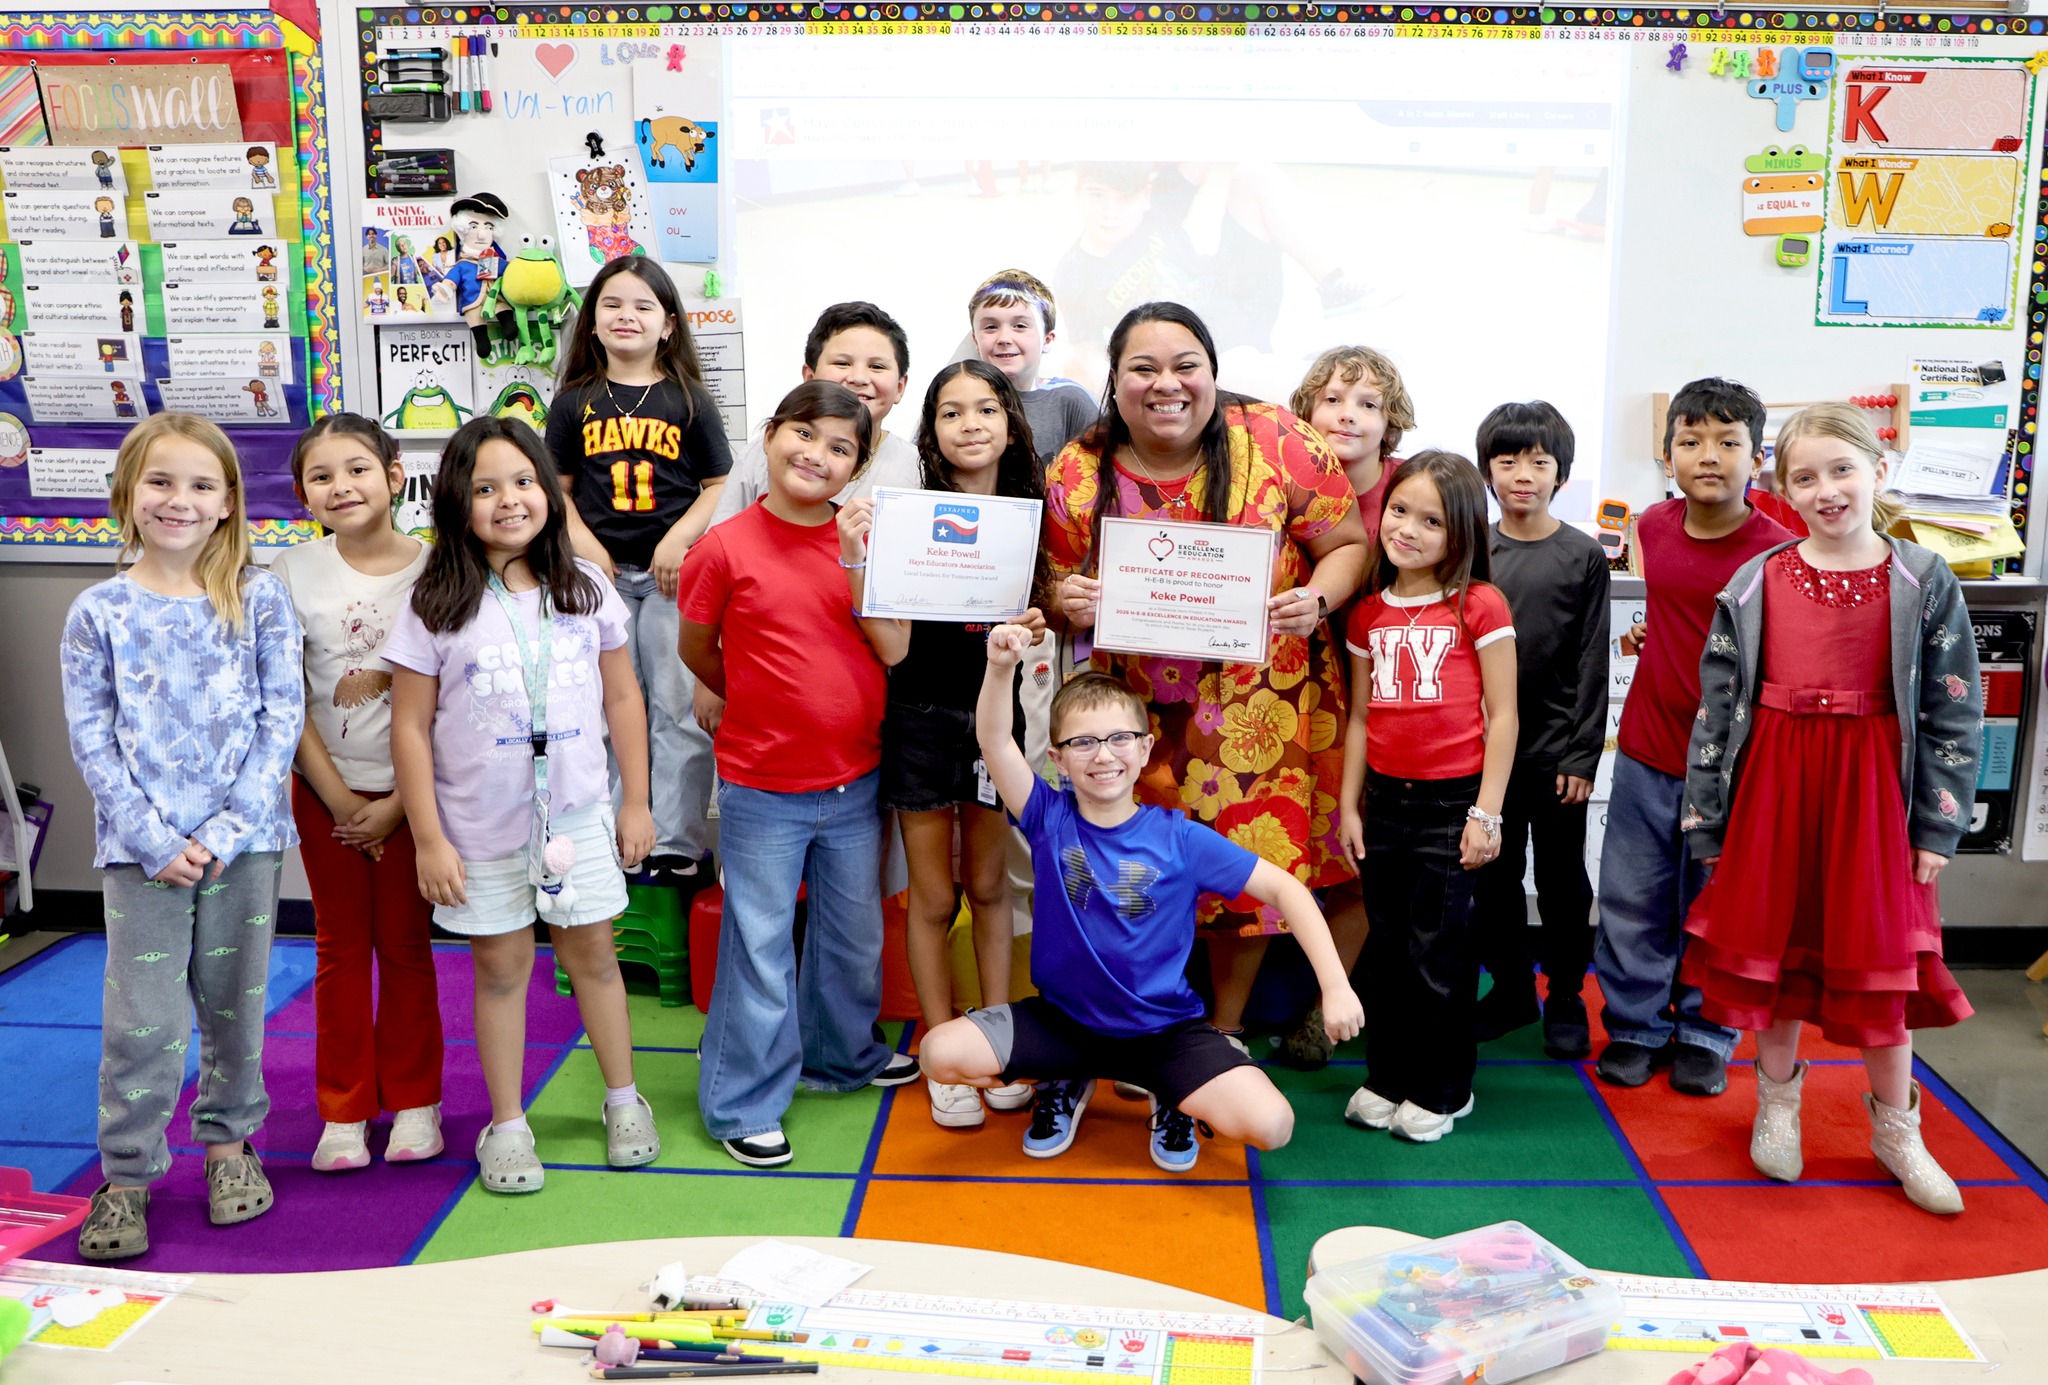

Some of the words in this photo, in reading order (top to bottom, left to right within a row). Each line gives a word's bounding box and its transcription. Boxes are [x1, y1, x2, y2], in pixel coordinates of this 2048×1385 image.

[377, 30, 382, 39] 0
[390, 30, 393, 38] 1
[403, 30, 408, 39] 2
[418, 29, 422, 38] 3
[430, 29, 436, 38] 4
[445, 29, 450, 38] 5
[486, 29, 491, 37] 8
[498, 29, 503, 37] 9
[509, 29, 518, 37] 10
[969, 27, 980, 35] 42
[985, 27, 996, 35] 43
[1397, 28, 1407, 36] 71
[1412, 28, 1423, 37] 72
[1428, 29, 1438, 37] 73
[1442, 29, 1453, 37] 74
[1457, 29, 1468, 38] 75
[1472, 30, 1483, 38] 76
[1487, 30, 1498, 38] 77
[1502, 30, 1513, 38] 78
[1516, 30, 1527, 38] 79
[1530, 31, 1540, 39] 80
[1838, 36, 1848, 44] 101
[1852, 36, 1862, 45] 102
[1867, 36, 1877, 45] 103
[1881, 37, 1892, 46] 104
[1896, 37, 1906, 46] 105
[601, 42, 661, 65] LOVE
[1852, 72, 1876, 80] What
[1878, 72, 1883, 80] I
[1885, 72, 1912, 82] Know
[1773, 83, 1802, 94] PLUS
[47, 84, 131, 132] FOCUS
[1842, 85, 1891, 142] K
[1765, 158, 1802, 168] MINUS
[1845, 159, 1869, 167] What
[1871, 159, 1876, 167] I
[1878, 160, 1913, 168] Wonder
[169, 168, 196, 176] graphics
[1757, 202, 1764, 210] is
[1767, 200, 1798, 210] EQUAL
[1837, 172, 1904, 228] W
[377, 206, 424, 216] RAISING
[669, 207, 687, 216] ow
[392, 216, 444, 226] AMERICA
[1838, 245, 1861, 253] What
[1863, 245, 1868, 253] I
[1870, 245, 1908, 254] Learned
[1829, 257, 1868, 314] L
[686, 308, 736, 329] rpose
[1921, 365, 1958, 373] National
[1920, 374, 1958, 382] Certified
[584, 416, 681, 460] HAWKS
[1922, 465, 1949, 476] SPELLING
[1951, 470, 1966, 478] TEST
[610, 460, 656, 512] 11
[938, 506, 976, 515] TSTA/NEA
[927, 548, 948, 556] Keke
[951, 550, 980, 559] Powell
[926, 560, 958, 568] Educators
[1119, 566, 1174, 576] CERTIFICATE
[1191, 572, 1250, 582] RECOGNITION
[1151, 592, 1176, 601] Keke
[1180, 594, 1215, 604] Powell
[1147, 612, 1181, 620] EXCELLENCE
[1974, 625, 2002, 637] ONS
[477, 636, 580, 670] GRW
[1368, 626, 1456, 702] NY
[472, 660, 588, 697] SMES
